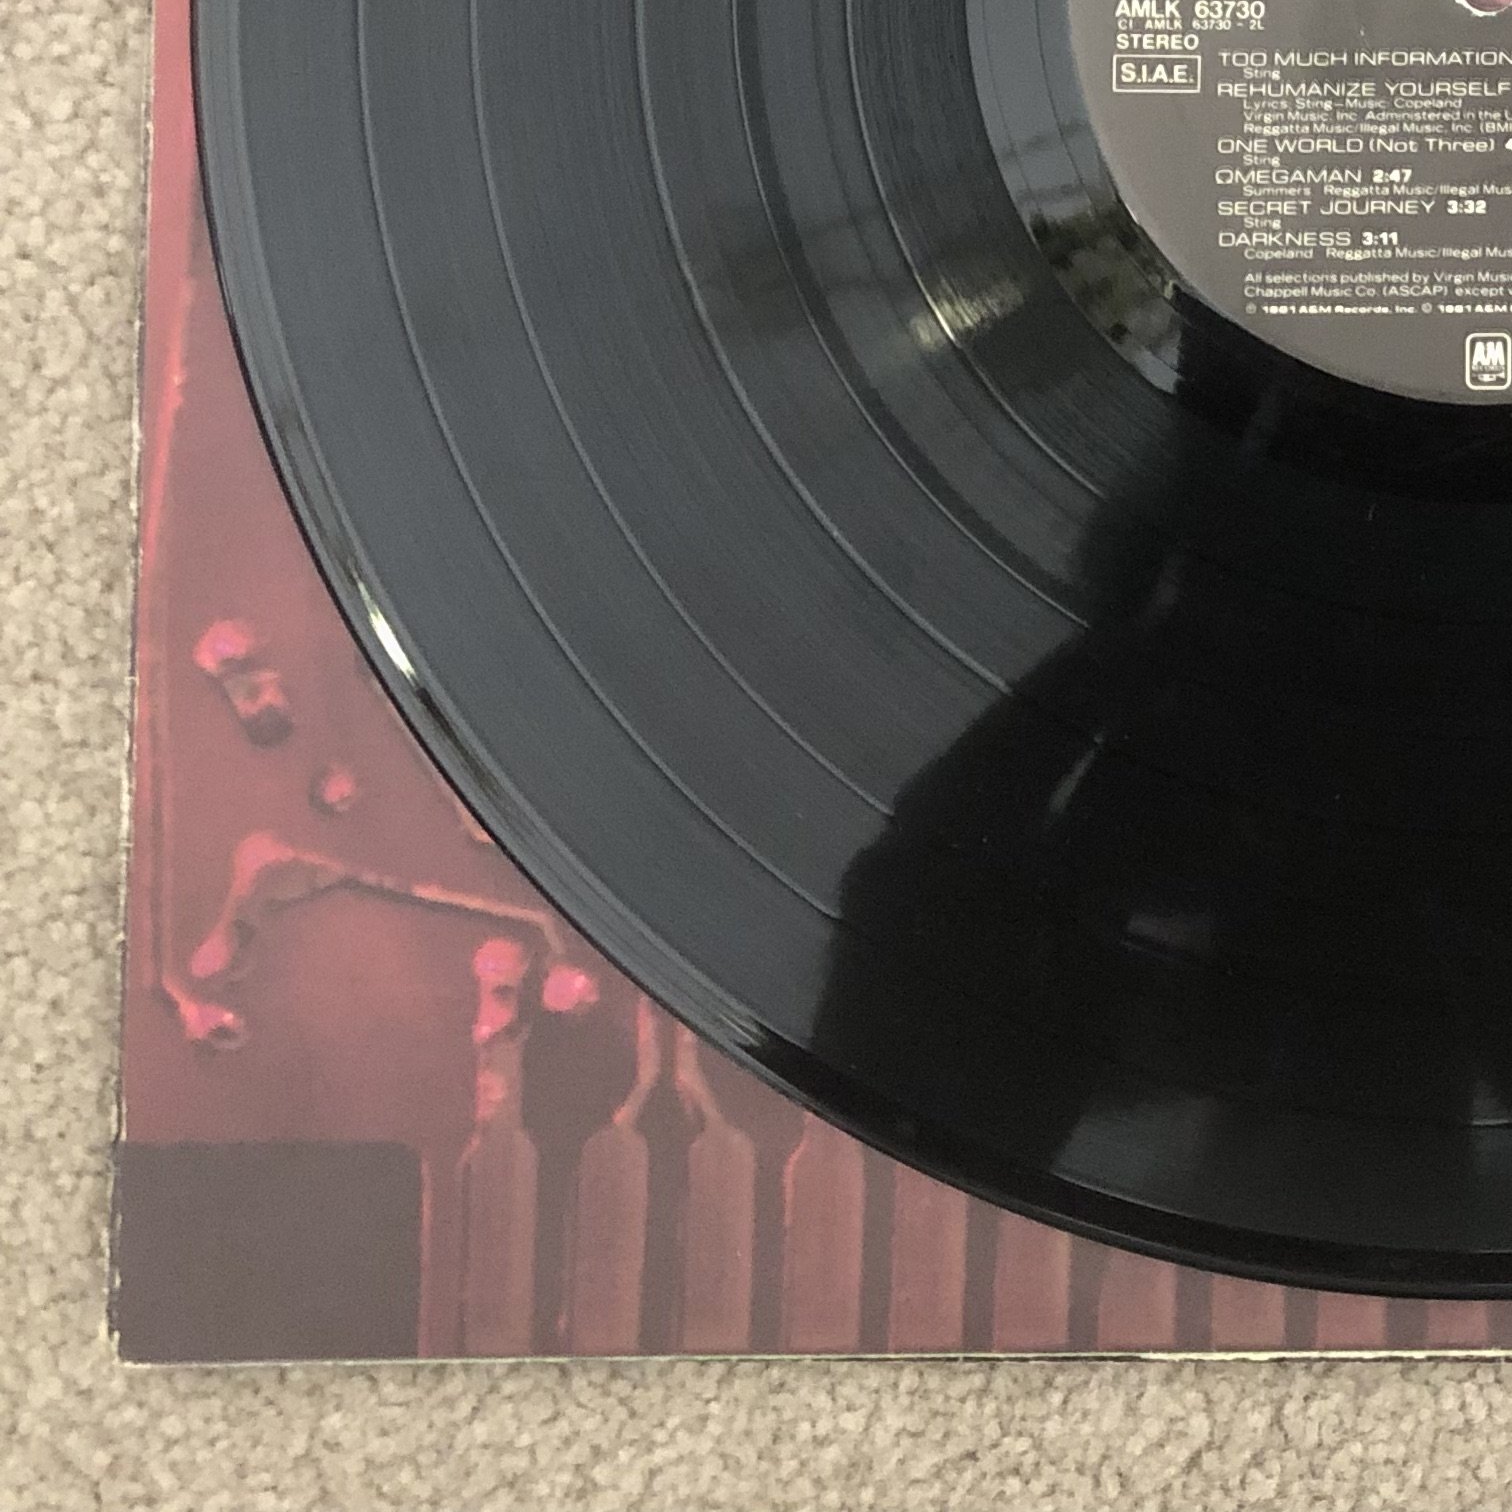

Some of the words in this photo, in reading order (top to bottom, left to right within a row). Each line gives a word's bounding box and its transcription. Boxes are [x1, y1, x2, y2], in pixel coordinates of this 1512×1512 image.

[1114, 0, 1182, 19] AMLK
[1194, 0, 1265, 20] 63730
[1144, 19, 1183, 30] AMLK
[1192, 18, 1232, 30] 63730
[1116, 34, 1200, 50] STEREO
[1218, 51, 1267, 66] TOO
[1274, 51, 1348, 66] MUCH
[1243, 67, 1281, 80] Sting
[1217, 82, 1376, 96] REHUMANIZE
[1384, 82, 1511, 96] YOURSELF
[1394, 99, 1462, 111] Copeland
[1243, 111, 1284, 124] Virgin
[1364, 110, 1460, 122] Administered
[1478, 110, 1501, 122] the
[1217, 139, 1268, 153] ONE
[1275, 139, 1363, 153] WORLD
[1369, 139, 1419, 153] (Not
[1425, 139, 1495, 153] Three)
[1243, 155, 1281, 167] Sting
[1372, 169, 1412, 183] 2:47
[1217, 200, 1311, 216] SECRET
[1320, 200, 1435, 216] JOURNEY
[1447, 200, 1487, 214] 3:32
[1243, 217, 1282, 230] Sting
[1218, 232, 1351, 248] DARKNESS
[1362, 231, 1399, 246] 3:11
[1244, 273, 1262, 284] All
[1265, 272, 1337, 284] selections
[1340, 272, 1409, 286] published
[1412, 272, 1430, 286] by
[1433, 272, 1475, 286] Virgin
[1244, 285, 1308, 299] Chappell
[1311, 285, 1353, 297] Music
[1455, 285, 1504, 298] except
